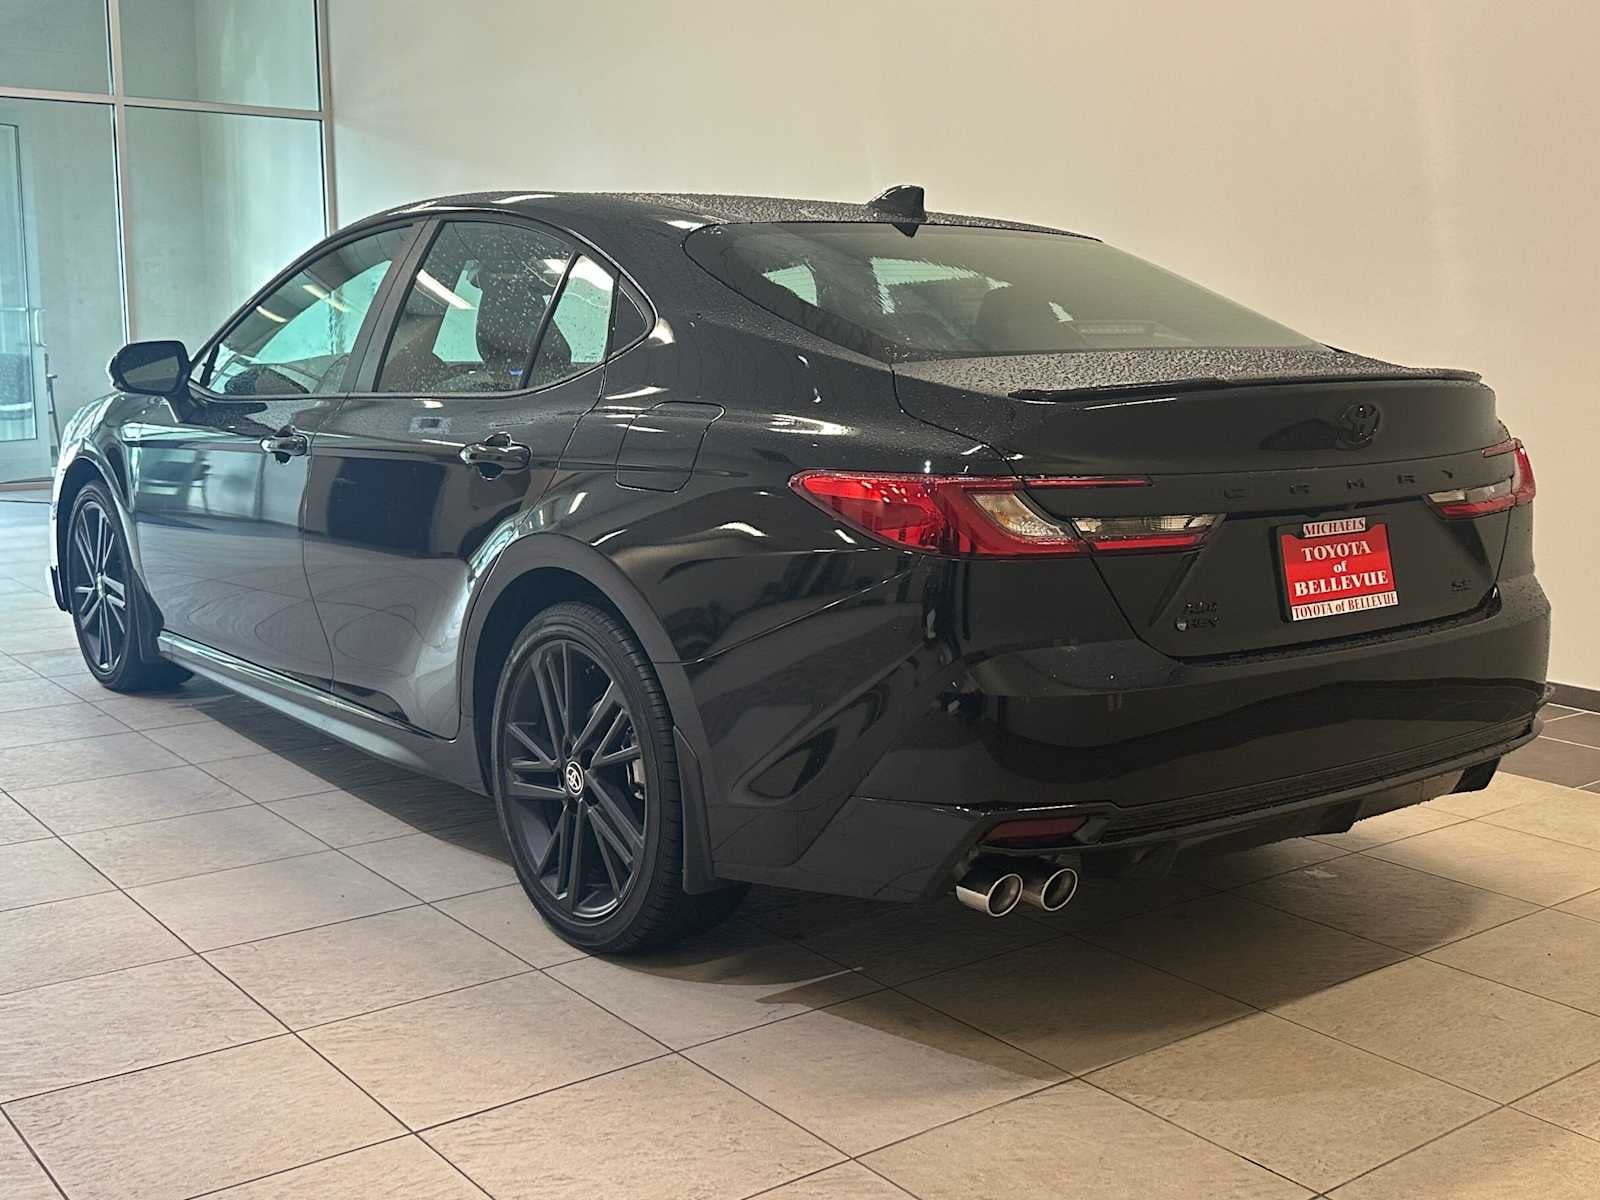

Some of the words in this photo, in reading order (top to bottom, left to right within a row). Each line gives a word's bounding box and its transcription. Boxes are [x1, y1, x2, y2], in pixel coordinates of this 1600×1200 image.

[1304, 518, 1365, 536] MICHAELS
[1301, 540, 1371, 562] TOYOTA
[1333, 560, 1347, 573] of
[1294, 570, 1389, 597] BELLEVUE
[1293, 602, 1333, 620] TOYOTA
[1335, 598, 1346, 613] of
[1347, 592, 1396, 611] BELLEVUE
